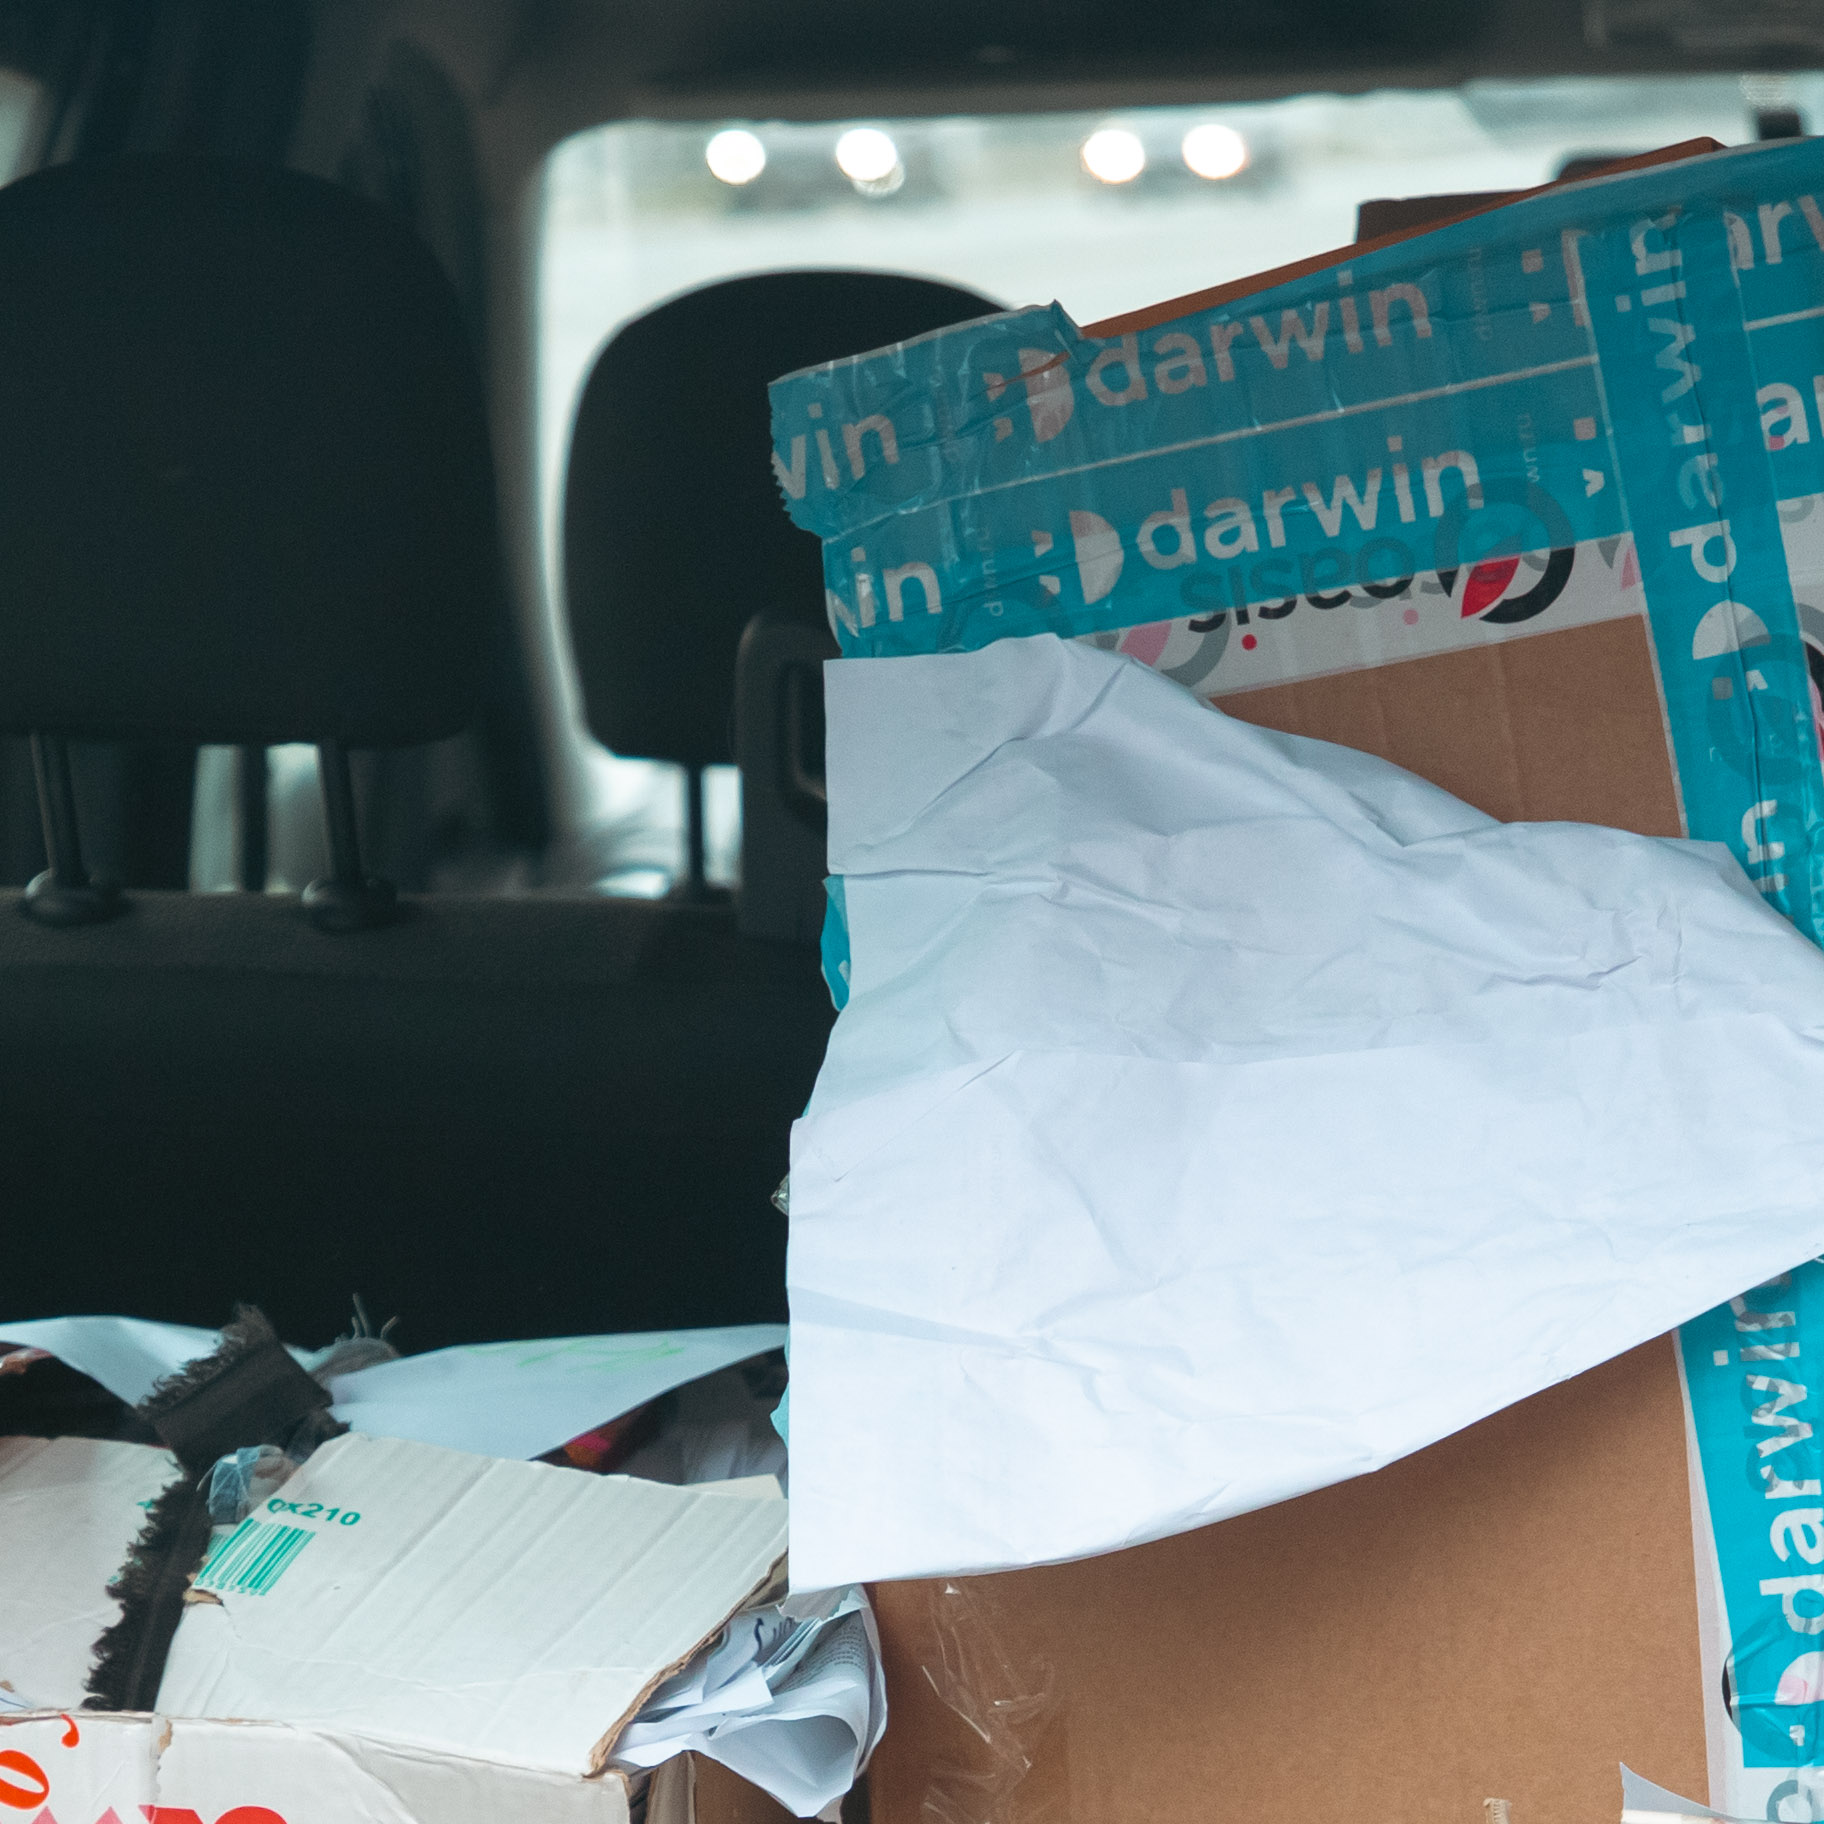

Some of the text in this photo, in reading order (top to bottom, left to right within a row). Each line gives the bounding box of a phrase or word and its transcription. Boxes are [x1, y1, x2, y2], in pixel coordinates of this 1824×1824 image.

[1084, 272, 1433, 408] darwin
[1614, 205, 1738, 584] darwin
[1137, 436, 1484, 571] darwin
